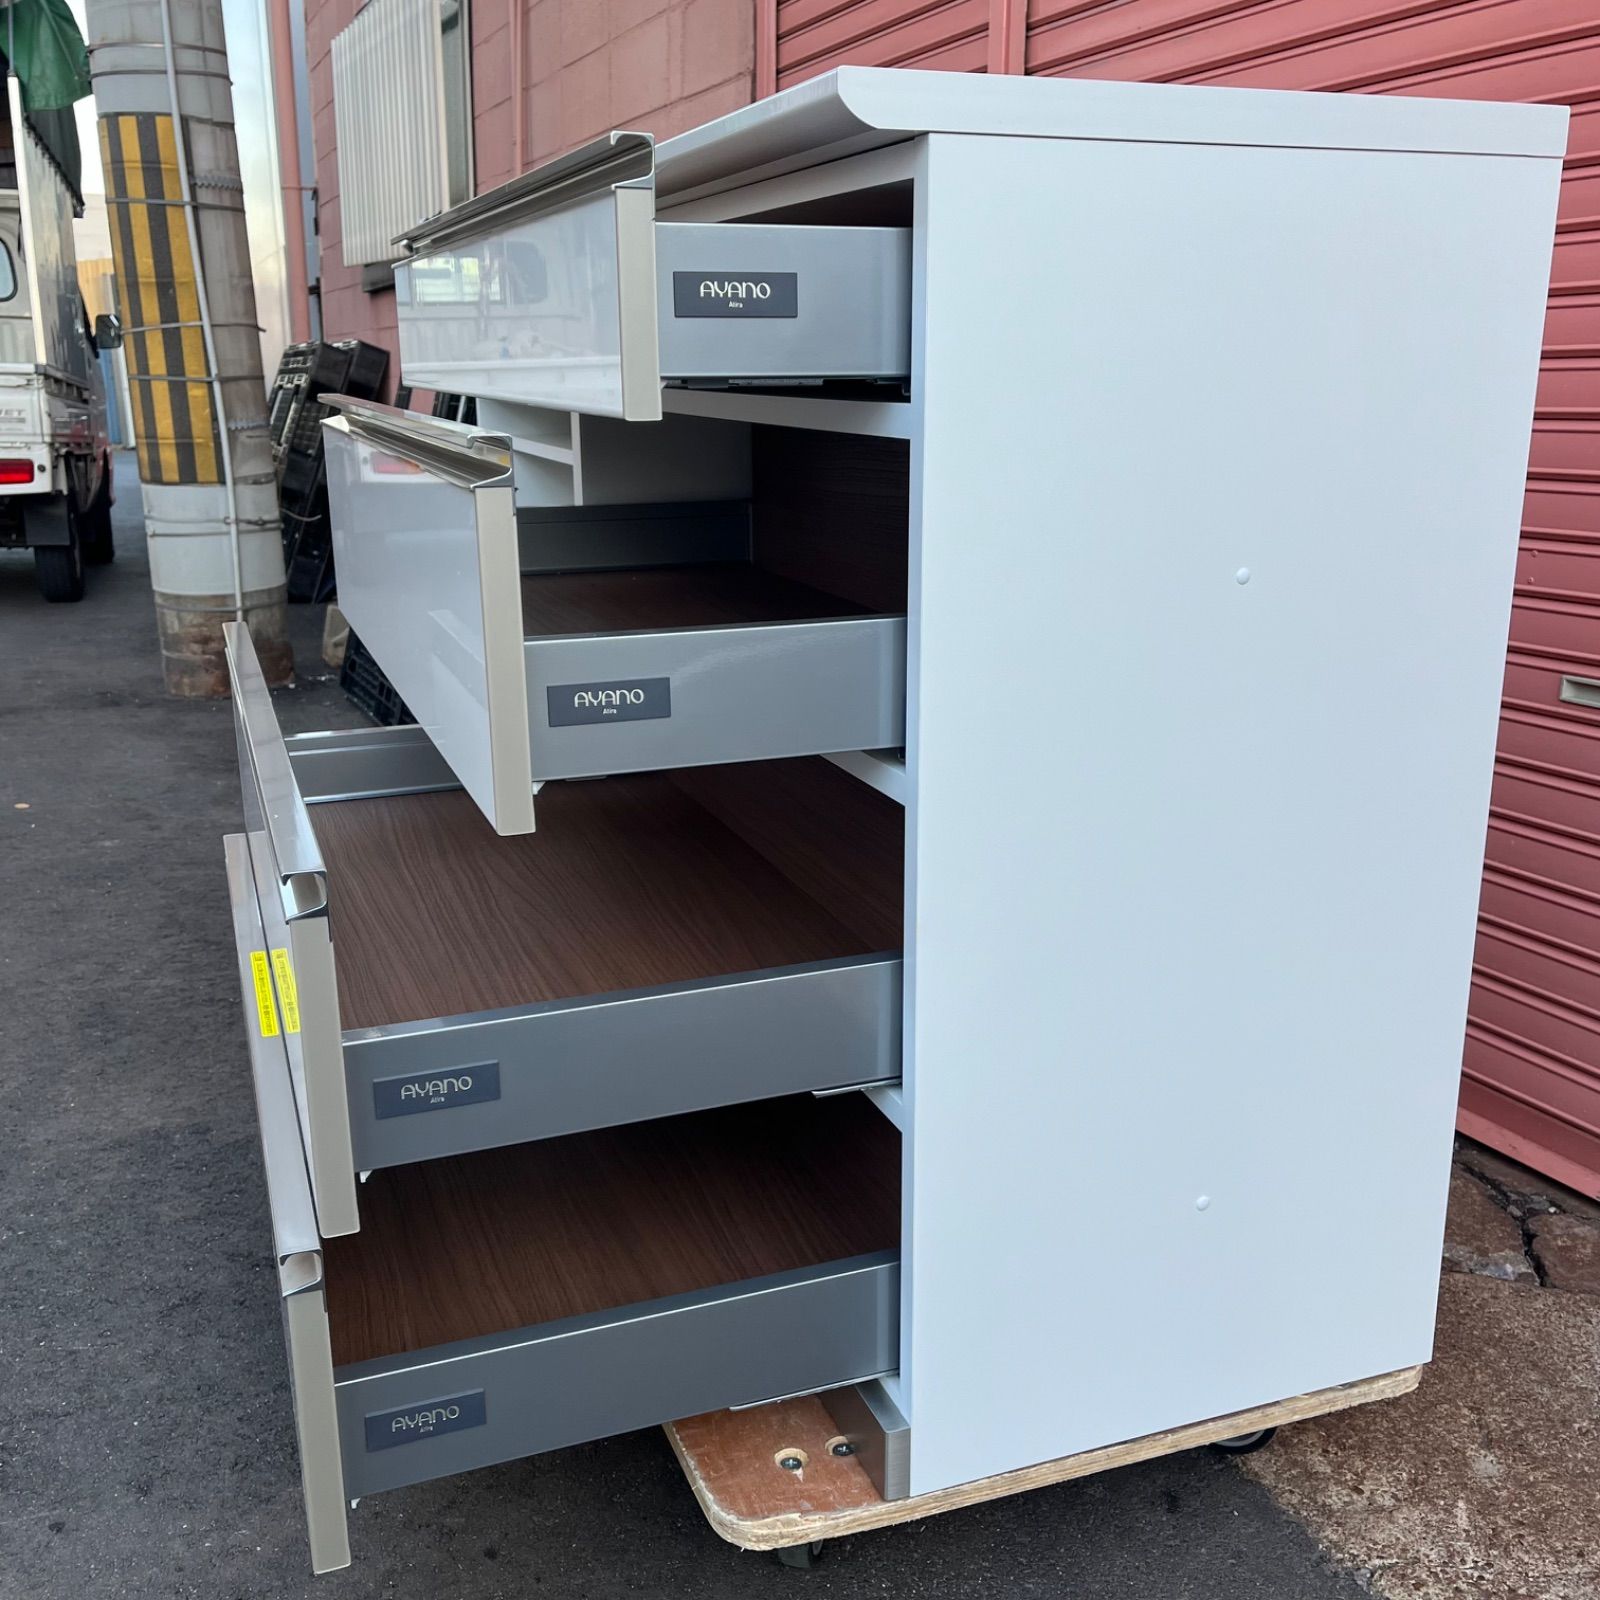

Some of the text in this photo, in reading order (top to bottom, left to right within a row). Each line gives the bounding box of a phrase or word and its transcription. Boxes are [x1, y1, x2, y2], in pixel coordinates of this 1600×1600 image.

[700, 280, 771, 299] AYANO
[574, 688, 644, 708] AYANO
[401, 1076, 473, 1100] AYANO
[391, 1405, 460, 1433] AYANO
